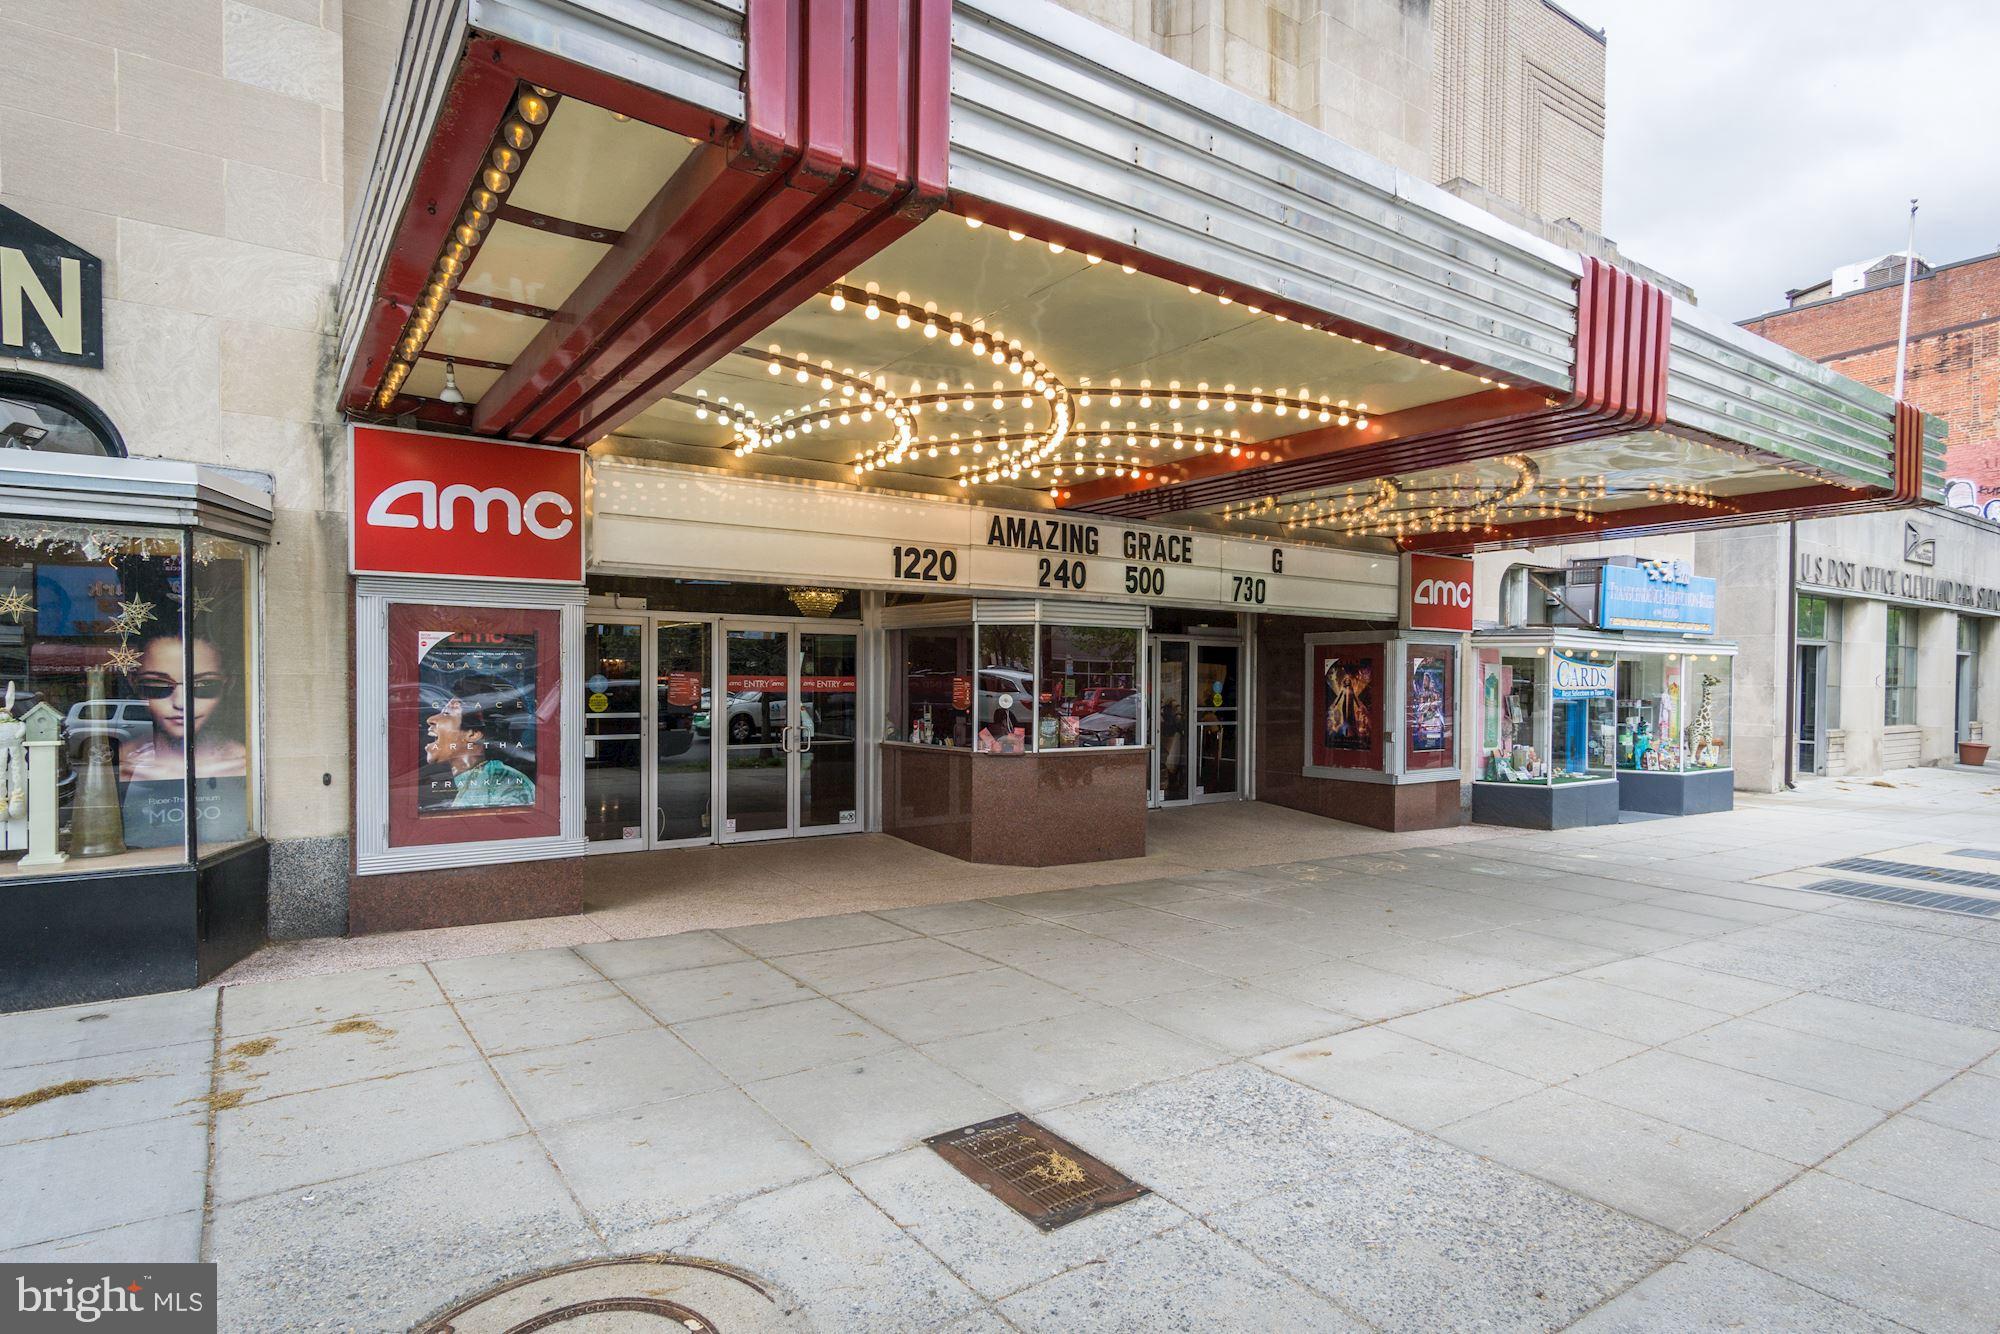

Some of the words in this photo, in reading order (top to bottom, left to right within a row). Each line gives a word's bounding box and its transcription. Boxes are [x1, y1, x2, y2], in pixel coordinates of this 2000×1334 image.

[0, 246, 83, 355] N
[988, 515, 1099, 555] AMAZING
[1123, 531, 1192, 563] GRACE
[1272, 549, 1283, 573] G
[893, 546, 957, 581] 1220
[1039, 558, 1086, 589] 240
[1125, 566, 1164, 595] 500
[1233, 576, 1266, 604] 730
[1828, 558, 1856, 588] POST
[1861, 566, 1898, 596] OFFICE
[1901, 571, 1954, 604] CLEVELAND
[431, 662, 523, 670] AMAZING
[1557, 661, 1607, 687] CARDS
[743, 680, 769, 688] ENTRY
[816, 680, 840, 688] ENTRY
[432, 741, 523, 750] ARETHA
[431, 777, 523, 788] FRANKLIN
